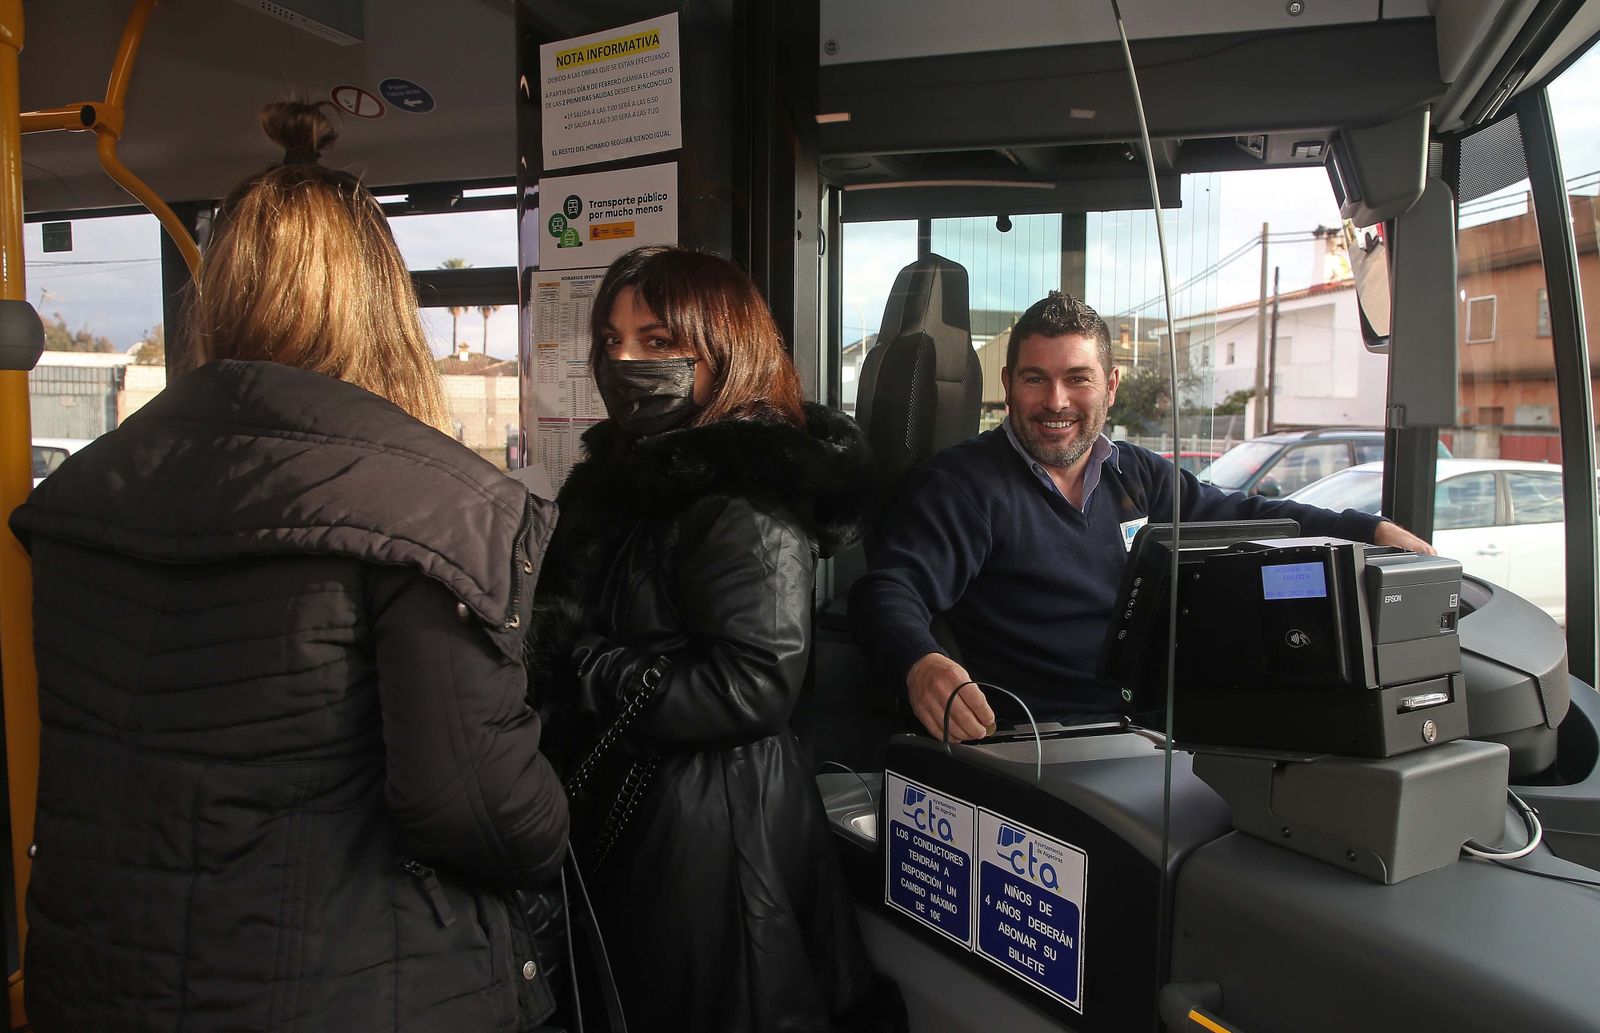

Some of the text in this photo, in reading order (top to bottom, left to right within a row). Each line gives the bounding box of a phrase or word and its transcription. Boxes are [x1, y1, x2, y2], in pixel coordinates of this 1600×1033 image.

[556, 34, 660, 68] NOTA INFORMATIVA
[547, 75, 567, 84] DEBIDO
[572, 71, 581, 79] LAS
[581, 67, 599, 77] OBRAS
[599, 65, 610, 73] QUE
[611, 63, 618, 71] SE
[636, 52, 671, 65] EFECTUANDO
[549, 88, 567, 98] PARTIR
[567, 87, 577, 95] DEL
[577, 84, 586, 93] DÍA
[598, 78, 622, 88] FEBRERO
[622, 74, 642, 83] CAMBIA
[650, 66, 674, 77] HORARIO
[552, 100, 562, 108] LAS
[566, 95, 592, 104] PRIMERAS
[592, 90, 614, 100] SALIDAS
[615, 86, 631, 96] DESDE
[573, 109, 591, 119] SALIDA
[597, 106, 607, 114] LAS
[618, 100, 632, 110] SERÁ
[637, 98, 647, 106] LAS
[573, 120, 592, 128] SALIDA
[597, 117, 607, 125] LAS
[618, 111, 632, 121] SERÁ
[637, 109, 647, 117] LAS
[552, 129, 672, 157] EL RESTO DEL HORARIO SEGUIRÁ SIENDO IGUAL
[589, 192, 668, 209] Transporte público
[589, 204, 664, 222] por mucho menos
[1384, 594, 1402, 604] EPSON
[914, 799, 957, 845] cta
[896, 827, 964, 867] LOS CONDUCTORES
[901, 861, 957, 898] DISPOSICIÓN UN
[909, 849, 950, 878] TENDRÁN A
[1011, 841, 1062, 892] cta
[900, 877, 958, 915] CAMBIO MÁXIMO
[915, 901, 941, 922] DE 10€
[1004, 883, 1053, 917] NIÑOS DE
[984, 894, 1073, 949] 4 AÑOS DEBERÁN
[998, 921, 1058, 961] ABONAR SU
[1008, 946, 1046, 976] BILLETE
